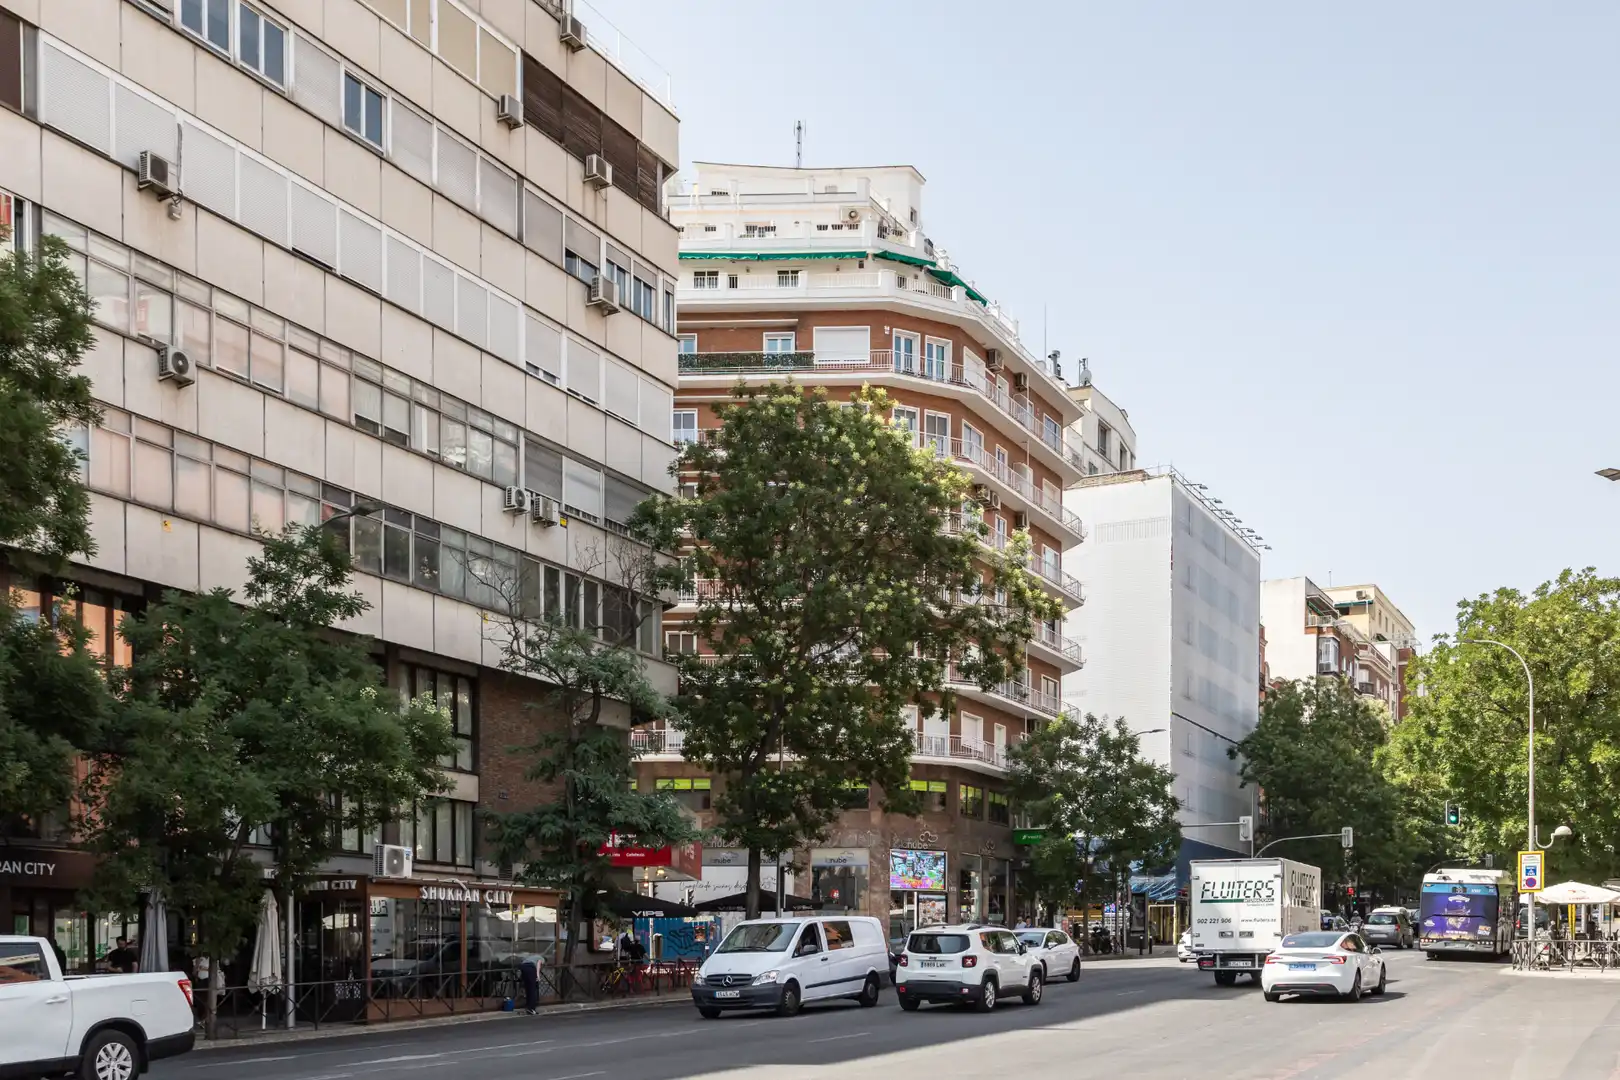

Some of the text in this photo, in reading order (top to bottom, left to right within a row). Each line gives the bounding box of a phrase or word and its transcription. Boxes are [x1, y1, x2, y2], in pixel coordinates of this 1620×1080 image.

[24, 862, 56, 876] CITY
[421, 886, 514, 904] SHUKRAN CITY
[1201, 880, 1274, 898] FLUITERS
